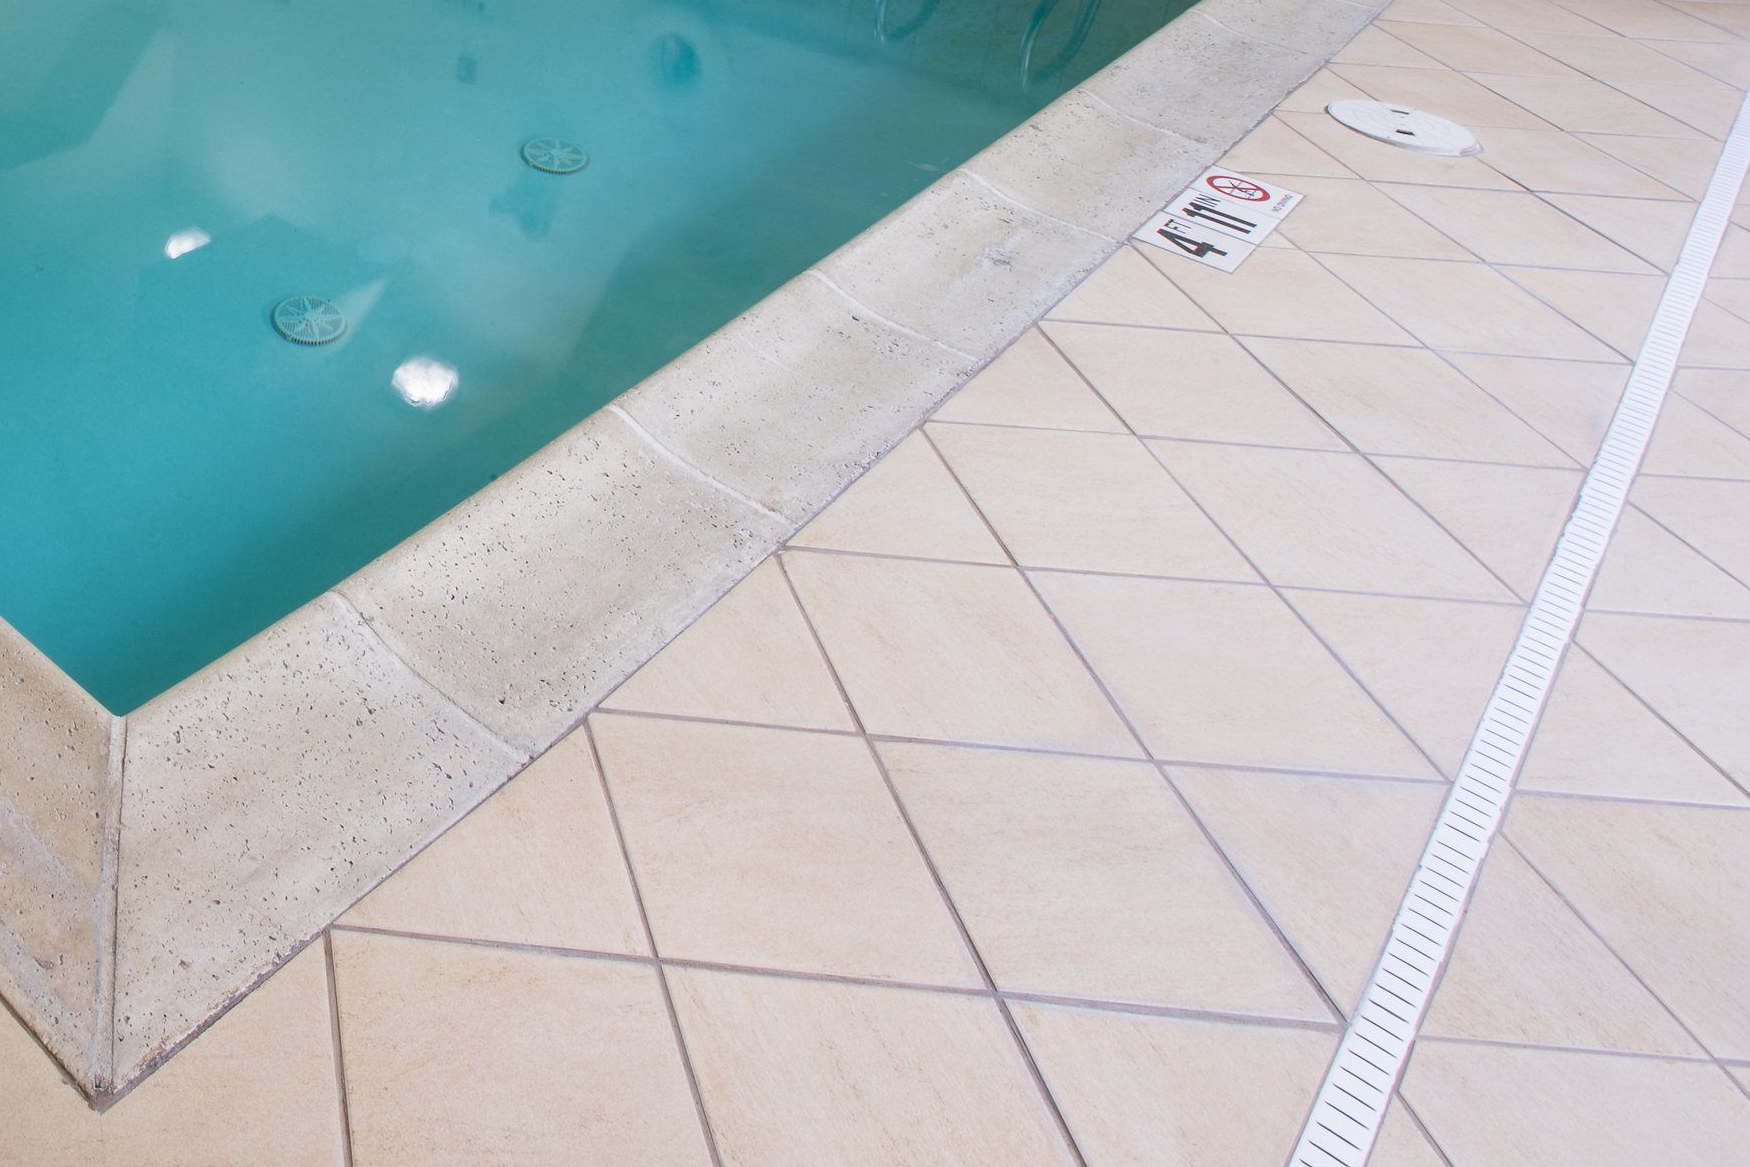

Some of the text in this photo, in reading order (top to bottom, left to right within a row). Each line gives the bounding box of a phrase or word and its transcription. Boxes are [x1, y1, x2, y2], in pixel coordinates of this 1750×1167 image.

[1156, 194, 1258, 258] 4 FT 11 IN
